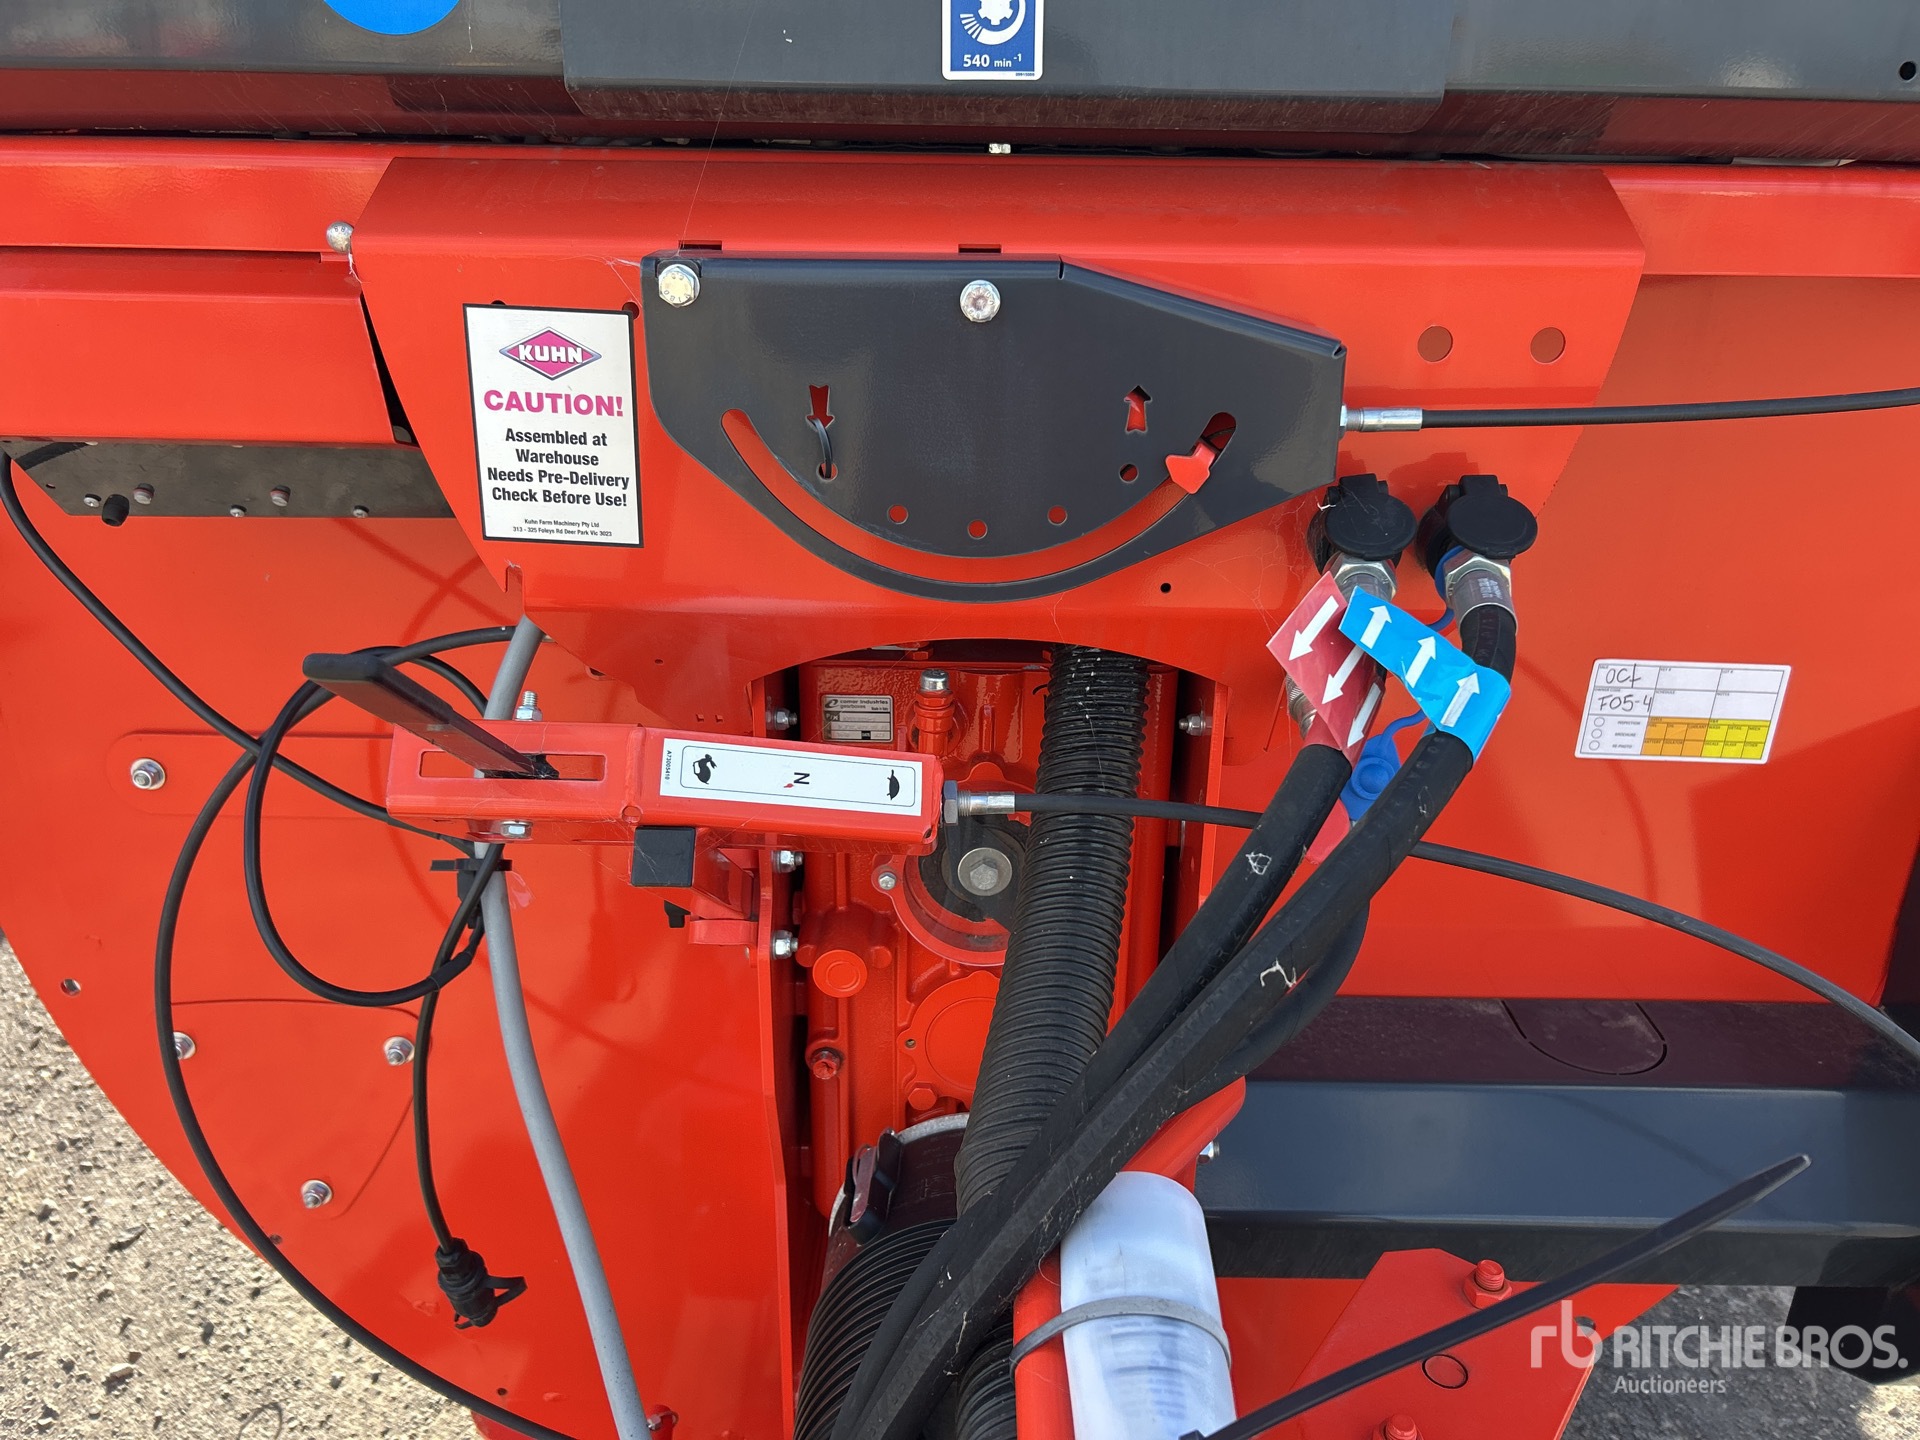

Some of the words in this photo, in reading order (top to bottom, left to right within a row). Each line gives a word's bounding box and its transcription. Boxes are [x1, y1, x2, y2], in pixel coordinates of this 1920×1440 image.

[963, 54, 990, 67] 540
[518, 344, 583, 364] KUHN
[484, 389, 624, 417] CAUTION!
[505, 428, 588, 446] Assembled
[592, 433, 608, 446] at
[515, 448, 599, 466] Warehouse
[487, 467, 534, 482] Needs
[538, 469, 630, 490] Pre-Delivery
[492, 487, 539, 502] Check
[542, 489, 591, 505] Before
[595, 492, 627, 507] Use!
[553, 520, 580, 528] Machinery
[793, 772, 810, 784] N
